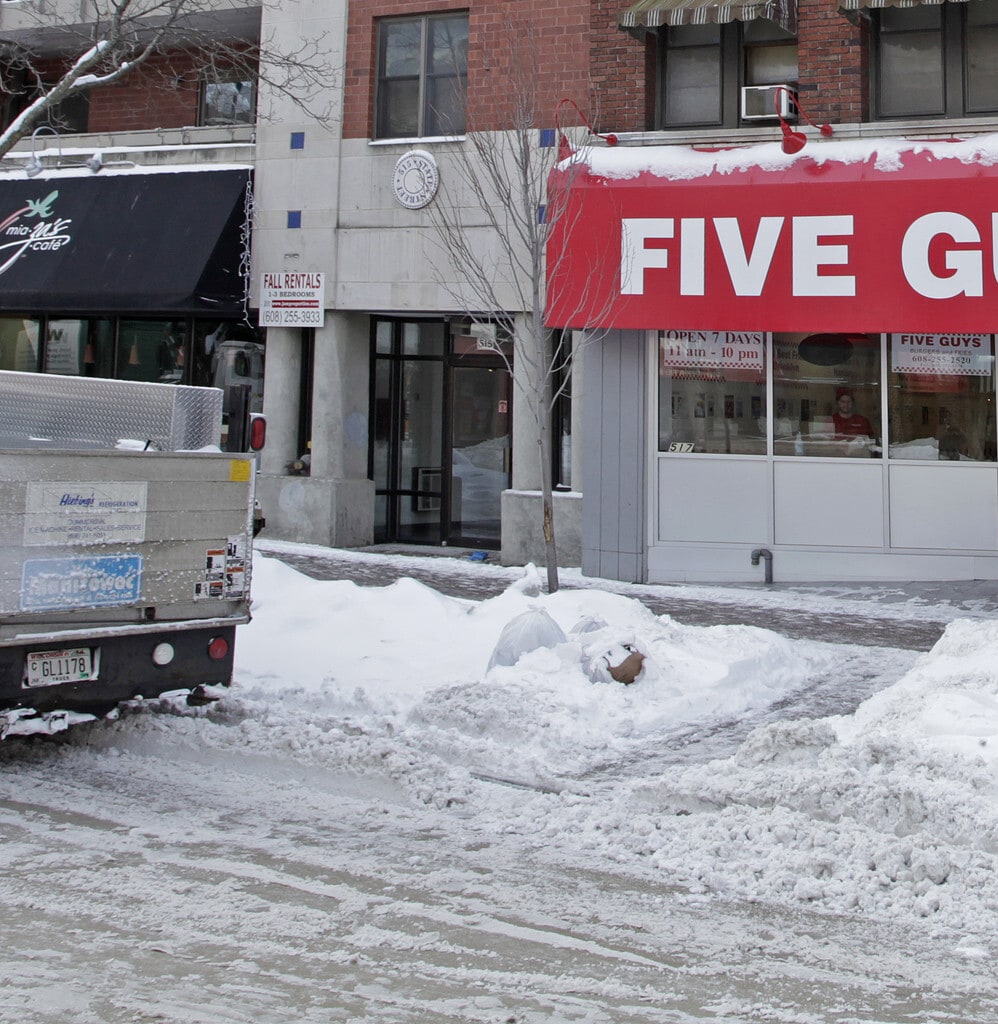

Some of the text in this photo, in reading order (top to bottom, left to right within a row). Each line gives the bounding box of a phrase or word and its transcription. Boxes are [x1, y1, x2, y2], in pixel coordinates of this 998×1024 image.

[620, 215, 856, 296] FIVE
[263, 273, 321, 289] FALL RENTALS
[262, 310, 321, 325] (608) 255-3933
[479, 339, 493, 348] 515
[666, 331, 761, 345] OPEN 7 DAYS
[900, 335, 982, 348] FIVE GUYS
[686, 347, 706, 357] am
[721, 347, 734, 358] 10
[738, 350, 759, 362] pm
[670, 443, 693, 452] 517
[42, 657, 86, 677] GL1178
